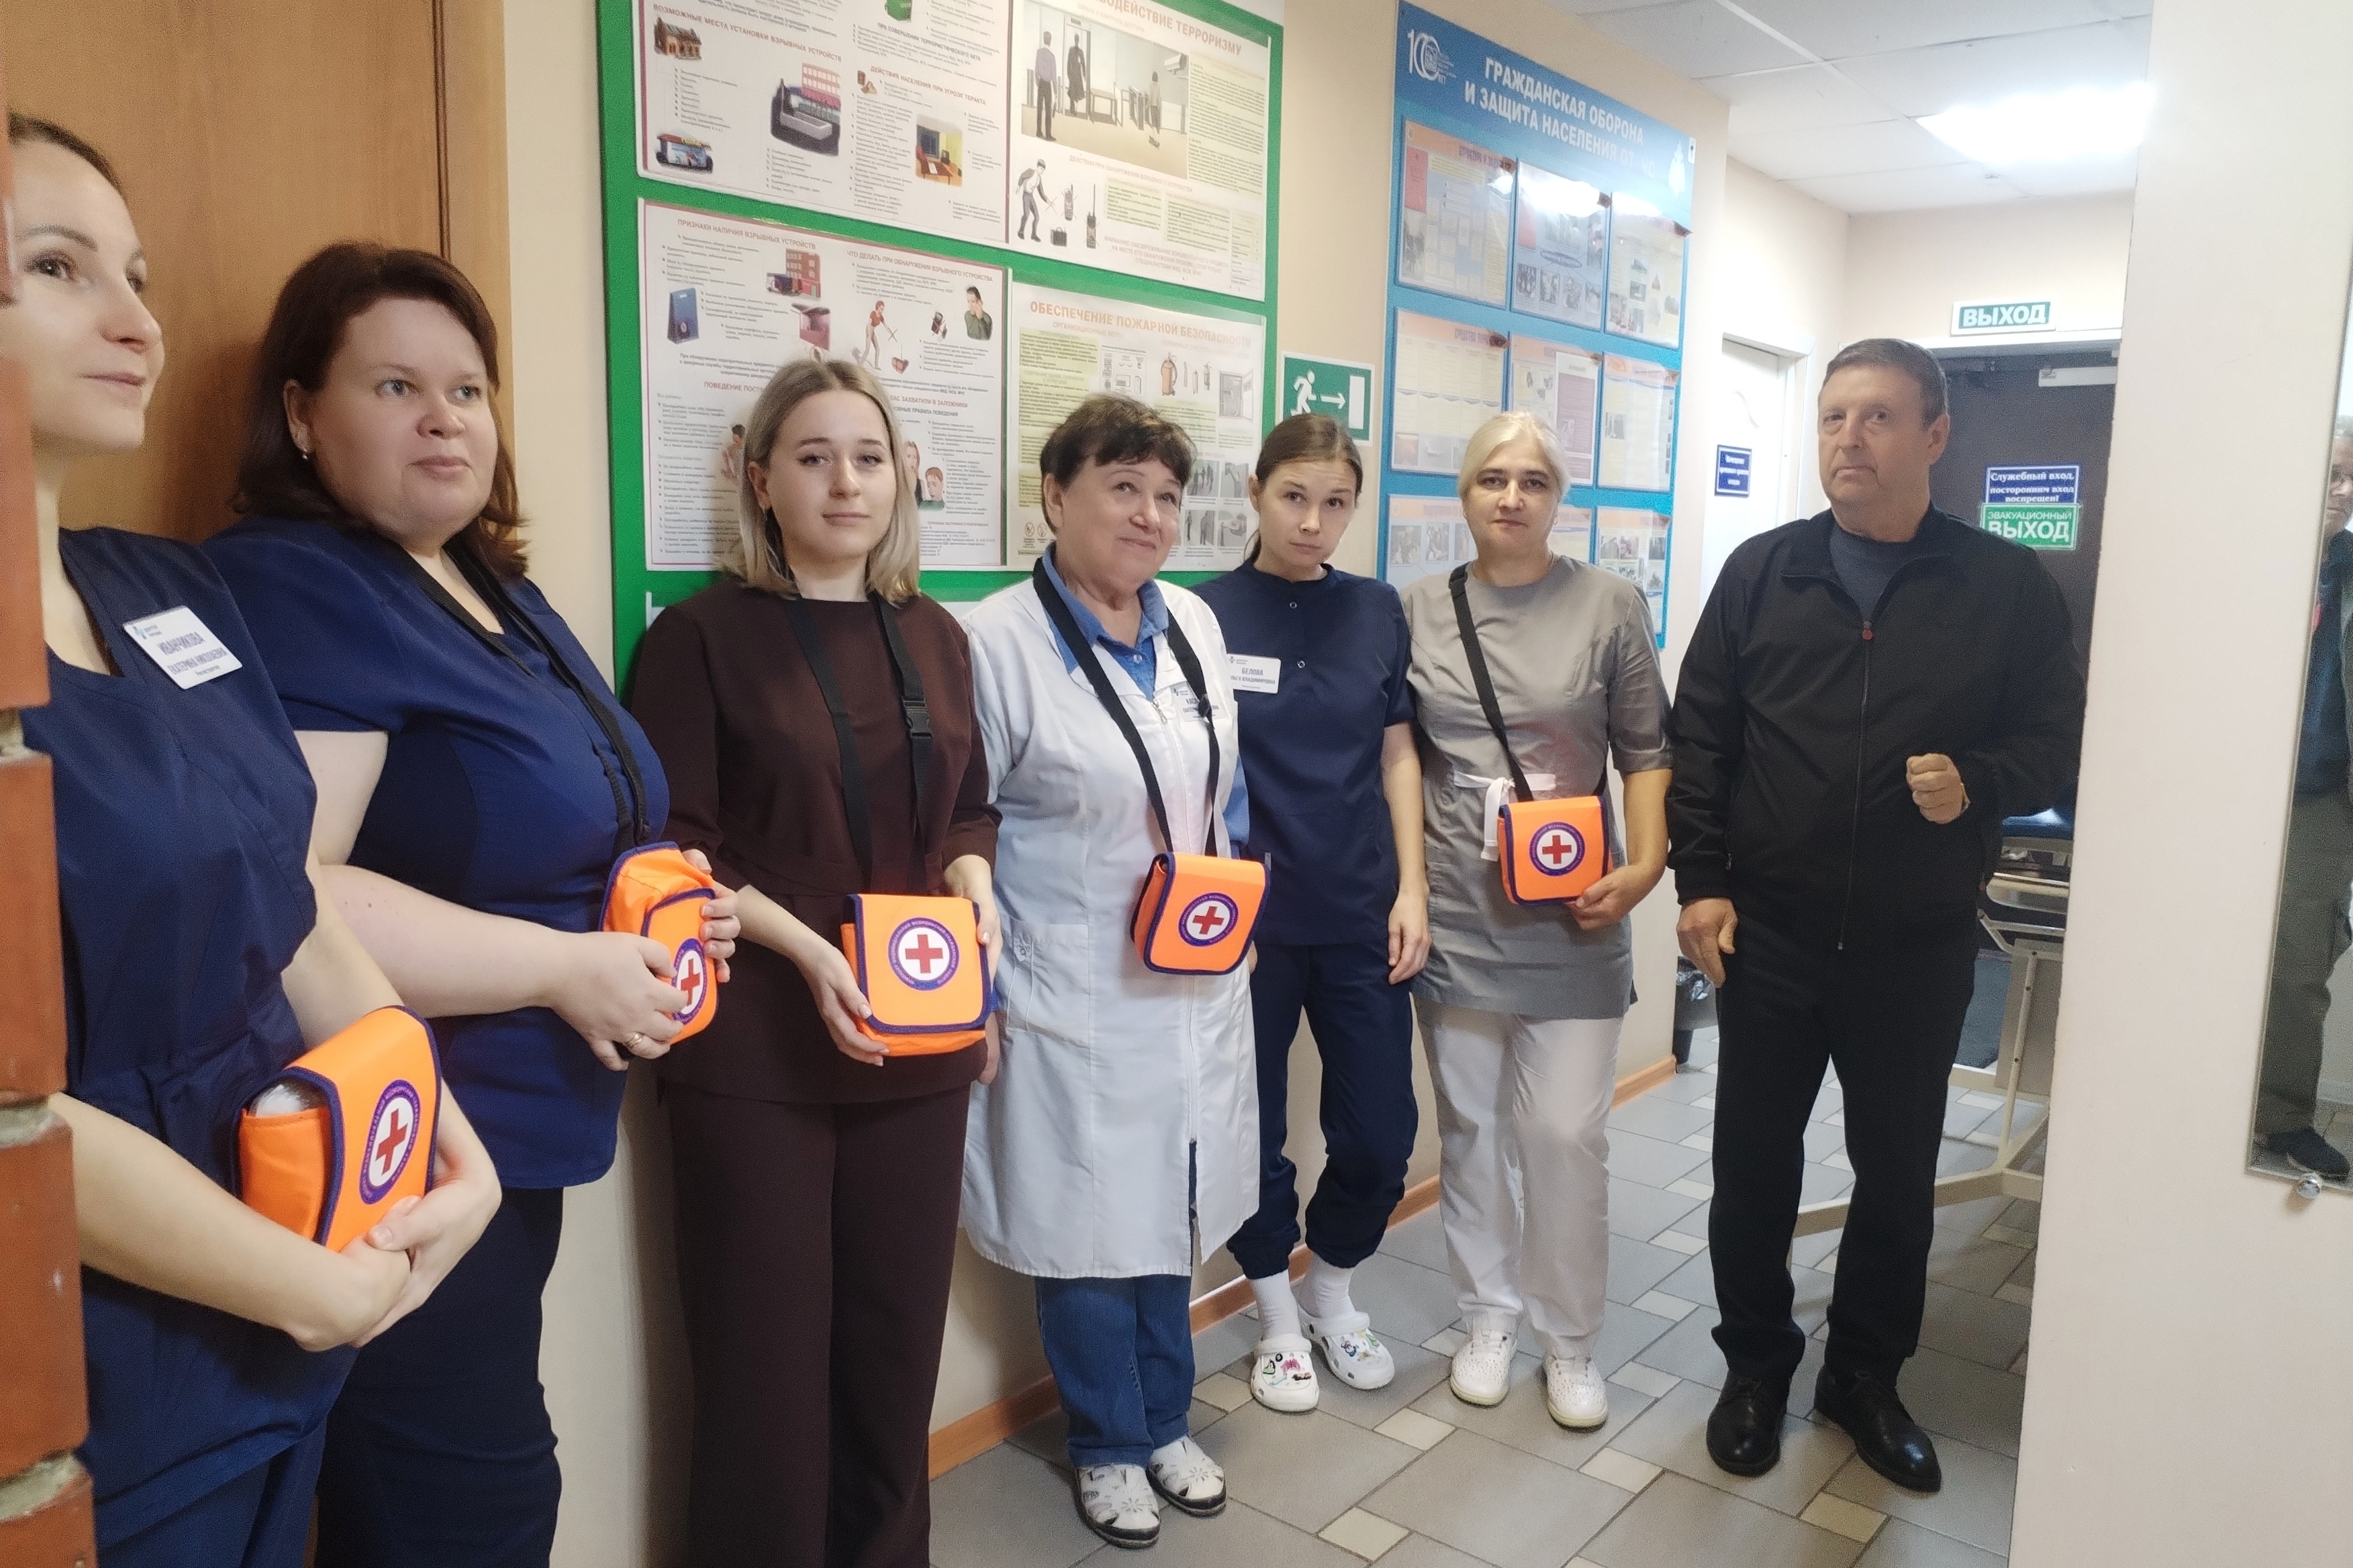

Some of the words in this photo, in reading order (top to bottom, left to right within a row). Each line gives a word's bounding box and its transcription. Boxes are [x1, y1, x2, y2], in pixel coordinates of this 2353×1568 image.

[653, 4, 702, 22] ВОЗМОЖНЫЕ
[704, 17, 727, 30] МЕСТА
[730, 24, 768, 40] УСТАНОВКИ
[771, 36, 806, 51] ВЗРЫВНЫХ
[807, 46, 842, 62] УСТРОЙСТВ
[1097, 0, 1173, 30] ОДЕЙСТВИЕ
[1176, 20, 1242, 56] ТЕРРОРИЗМУ
[888, 26, 920, 40] СОВЕРШЕНИИ
[921, 37, 969, 57] ТЕРРОРИСТИЧЕСКОГО
[970, 53, 980, 61] АКТА
[871, 66, 899, 78] ДЕЙСТВИЯ
[901, 75, 931, 88] НАСЕЛЕНИЯ
[933, 84, 943, 92] ПРИ
[945, 88, 963, 99] УГРОЗЕ
[965, 93, 986, 105] ТЕРАКТА
[1485, 57, 1586, 121] ГРАЖДАНСКАЯ
[1589, 105, 1643, 146] ОБОРОНА
[1465, 80, 1475, 105] И
[1480, 87, 1539, 131] ЗАЩИТА
[1542, 113, 1617, 161] НАСЕЛЕНИЯ
[1620, 149, 1635, 168] ОТ
[1641, 157, 1655, 178] ЧС
[1070, 155, 1094, 167] ДЕЙСТВИЯ
[677, 219, 712, 230] ПРИЗНАКИ
[713, 225, 743, 237] НАЛИЧИЯ
[745, 230, 780, 243] ВЗРЫВНЫХ
[781, 237, 815, 250] УСТРОЙСТВ
[859, 253, 881, 262] ДЕЛАТЬ
[894, 258, 931, 270] ОБНАРУЖЕНИИ
[932, 265, 962, 277] ВЗРЫВНОГО
[962, 270, 993, 282] УСТРОЙСТВА
[1030, 301, 1114, 325] ОБЕСПЕЧЕНИЕ
[1117, 316, 1178, 335] ПОЖАРНОЙ
[1181, 325, 1251, 347] БЕЗОПАСНОСТИ
[1963, 304, 2045, 326] ВЫХОД
[1053, 322, 1107, 336] ОРГАНИЗАЦИОННЫЕ
[704, 381, 742, 391] ПОВЕДЕНИЕ
[902, 396, 931, 405] ЗАХВАТИЛИ
[937, 399, 968, 408] ЗАЛОЖНИКИ
[1990, 471, 2046, 483] Служебный
[1990, 486, 2049, 494] посторонним
[2005, 495, 2059, 504] воспрещен!
[1987, 511, 2072, 520] ЭВАКУАЦИОННЫЙ
[1989, 521, 2069, 542] ВЫХОД
[1242, 668, 1263, 676] БЕЛОВА
